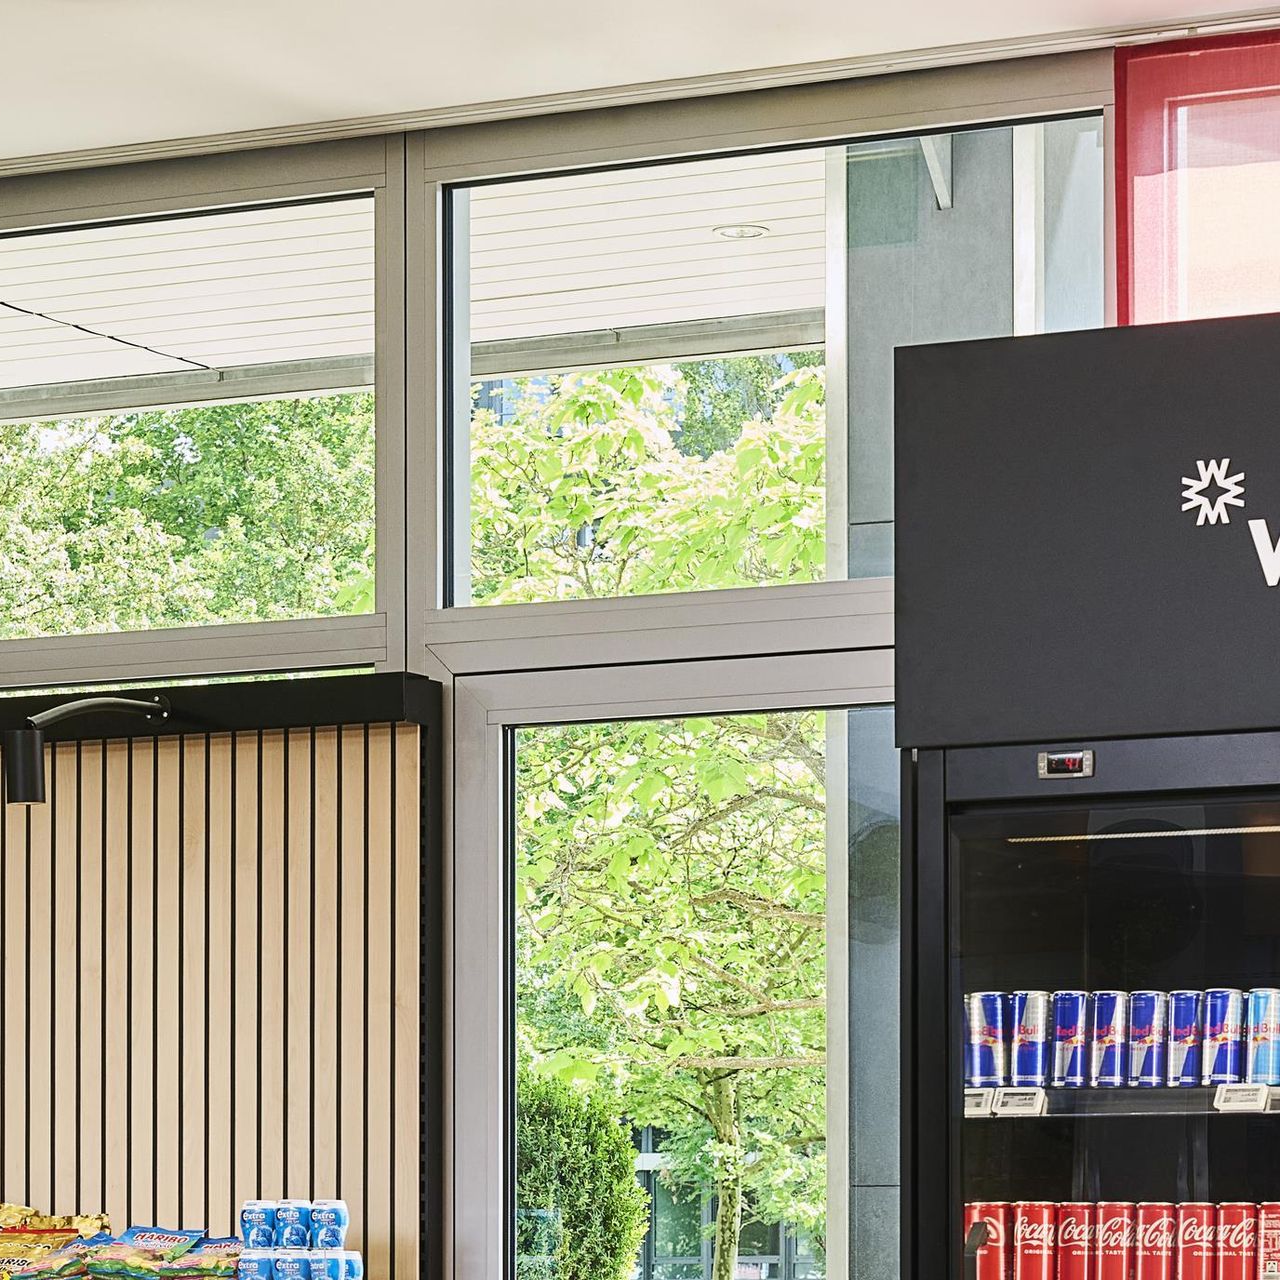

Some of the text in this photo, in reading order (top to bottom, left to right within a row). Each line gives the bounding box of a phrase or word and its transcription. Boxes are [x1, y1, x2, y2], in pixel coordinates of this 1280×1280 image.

[242, 1211, 266, 1221] extra
[276, 1210, 300, 1220] extra
[312, 1211, 335, 1221] extra
[132, 1232, 190, 1244] HARIBO
[238, 1260, 258, 1270] extra
[276, 1260, 300, 1270] extra
